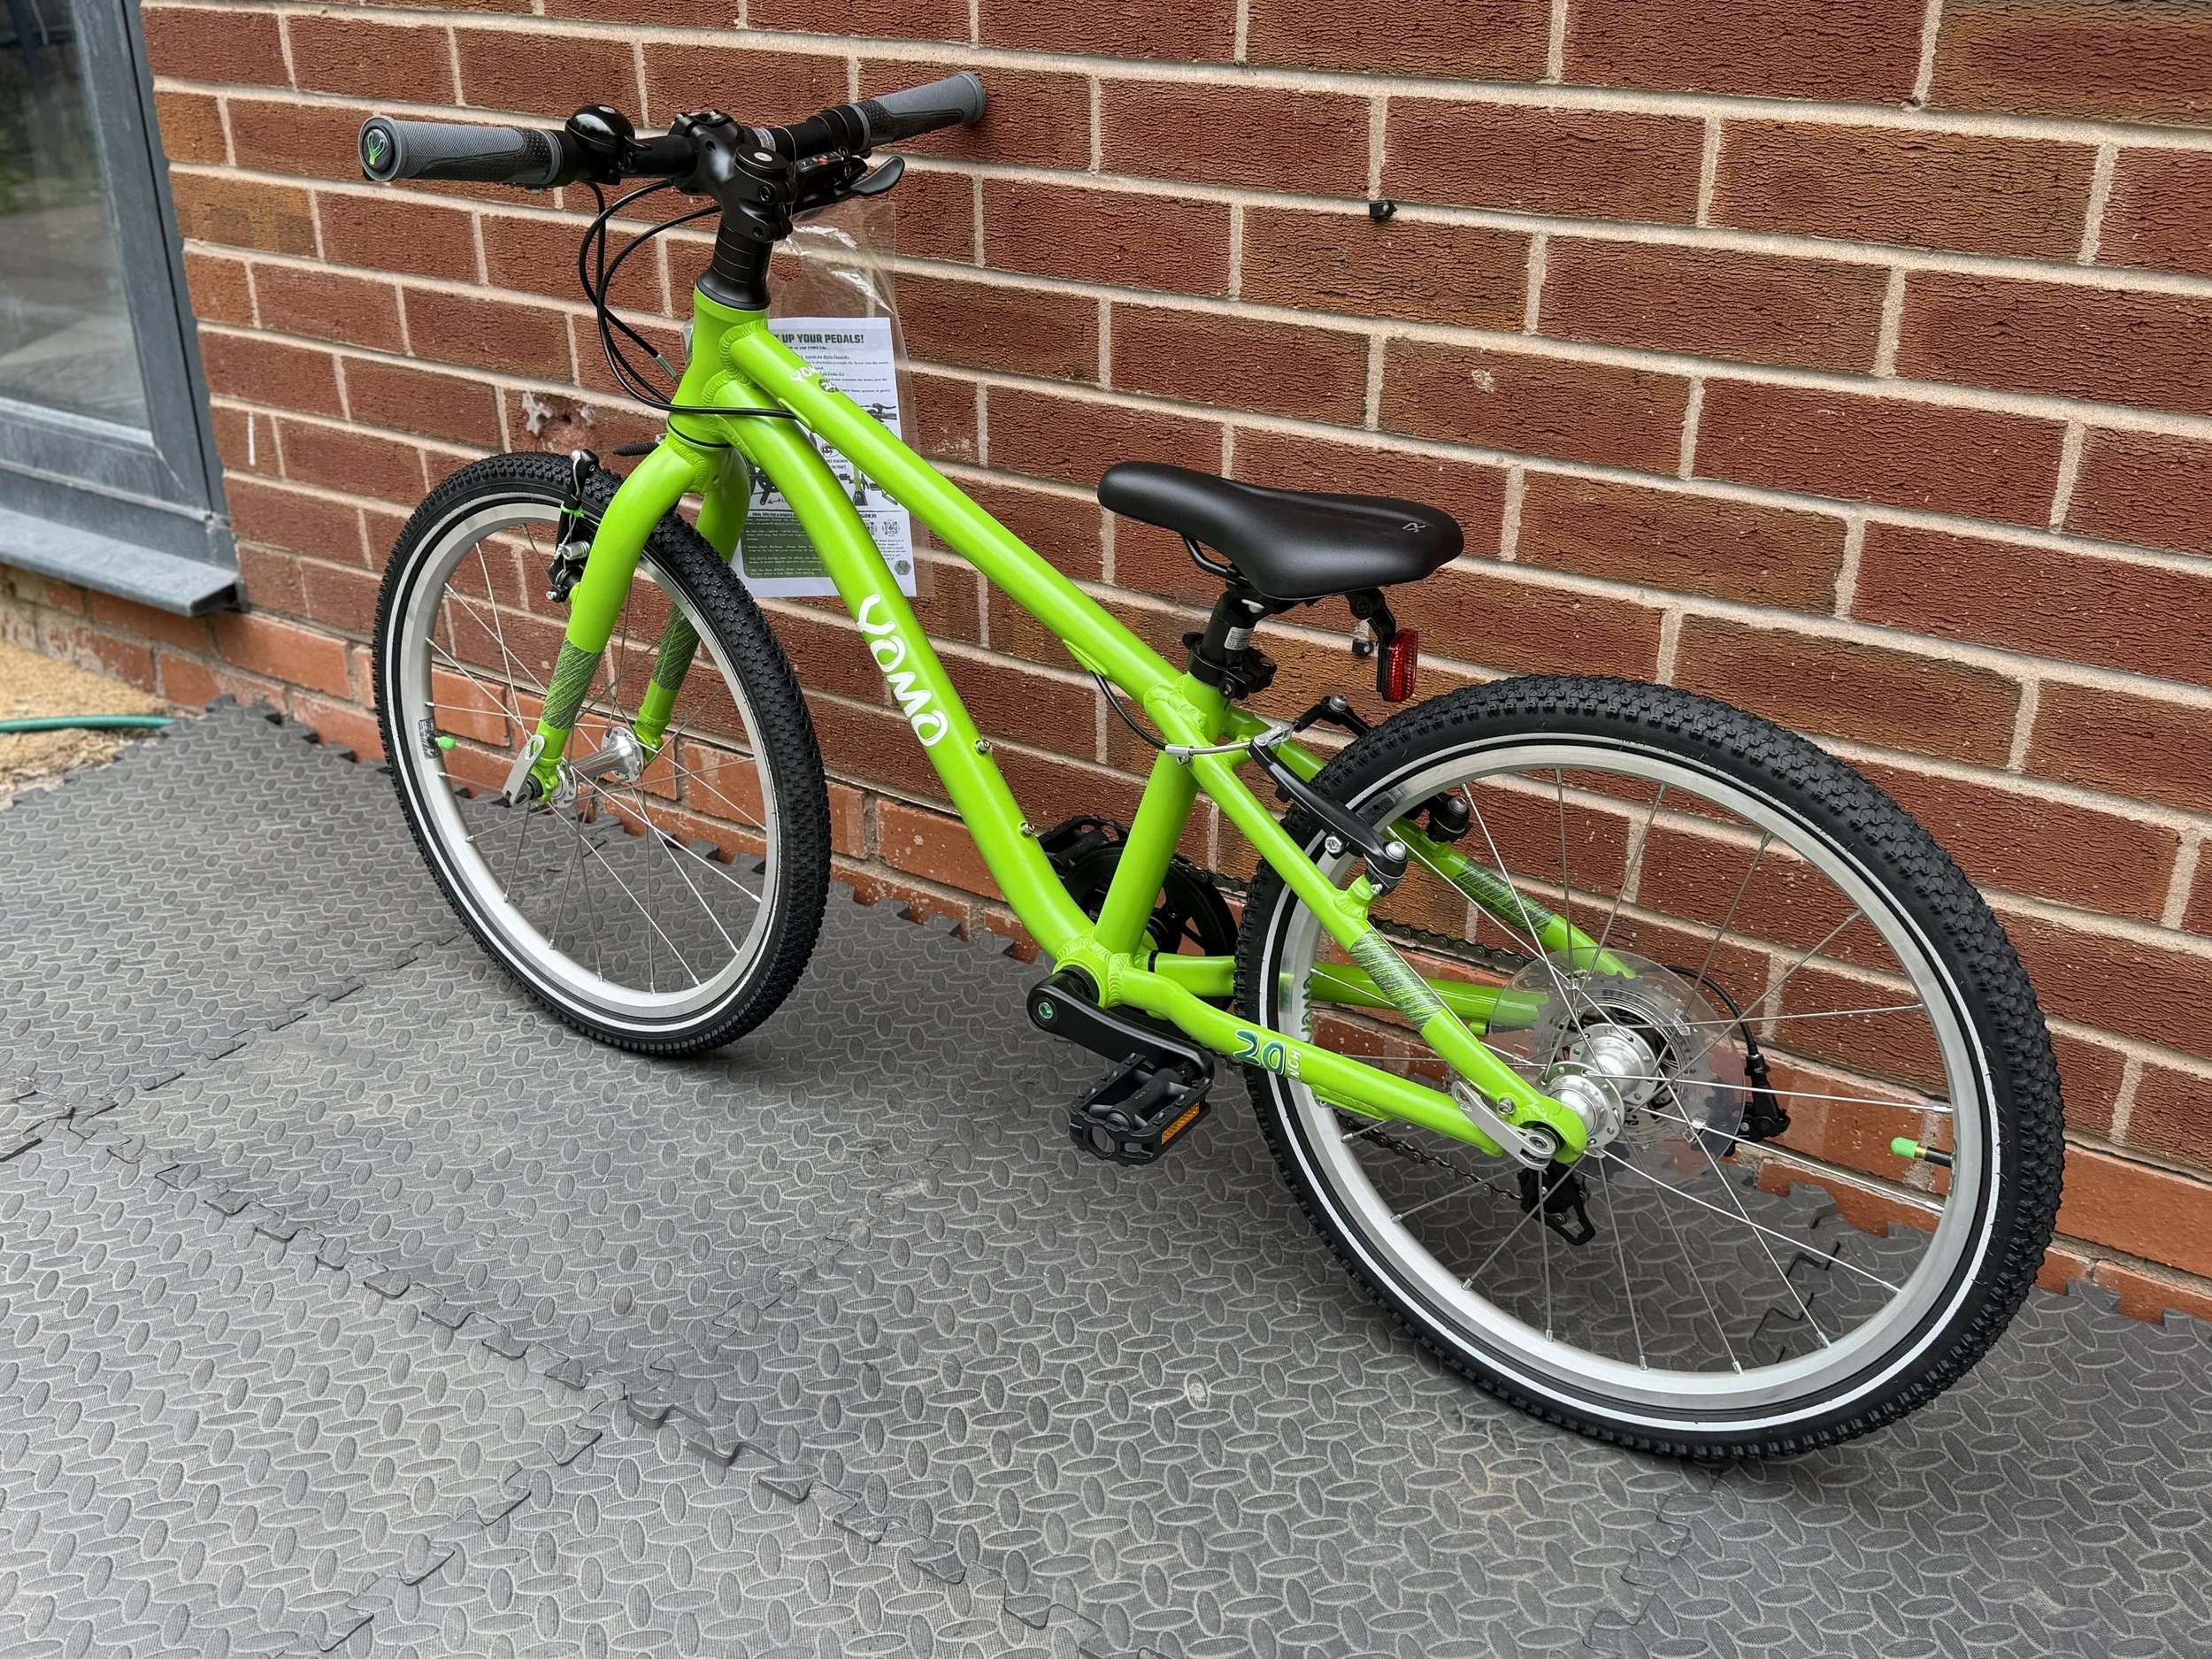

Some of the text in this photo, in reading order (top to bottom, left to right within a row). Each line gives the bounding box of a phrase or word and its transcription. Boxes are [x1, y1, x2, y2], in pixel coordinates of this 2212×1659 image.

[781, 334, 795, 343] UP
[796, 334, 823, 344] YOUR
[825, 334, 864, 344] PEDALS!
[856, 594, 949, 747] YOMO
[1233, 1028, 1286, 1075] 20
